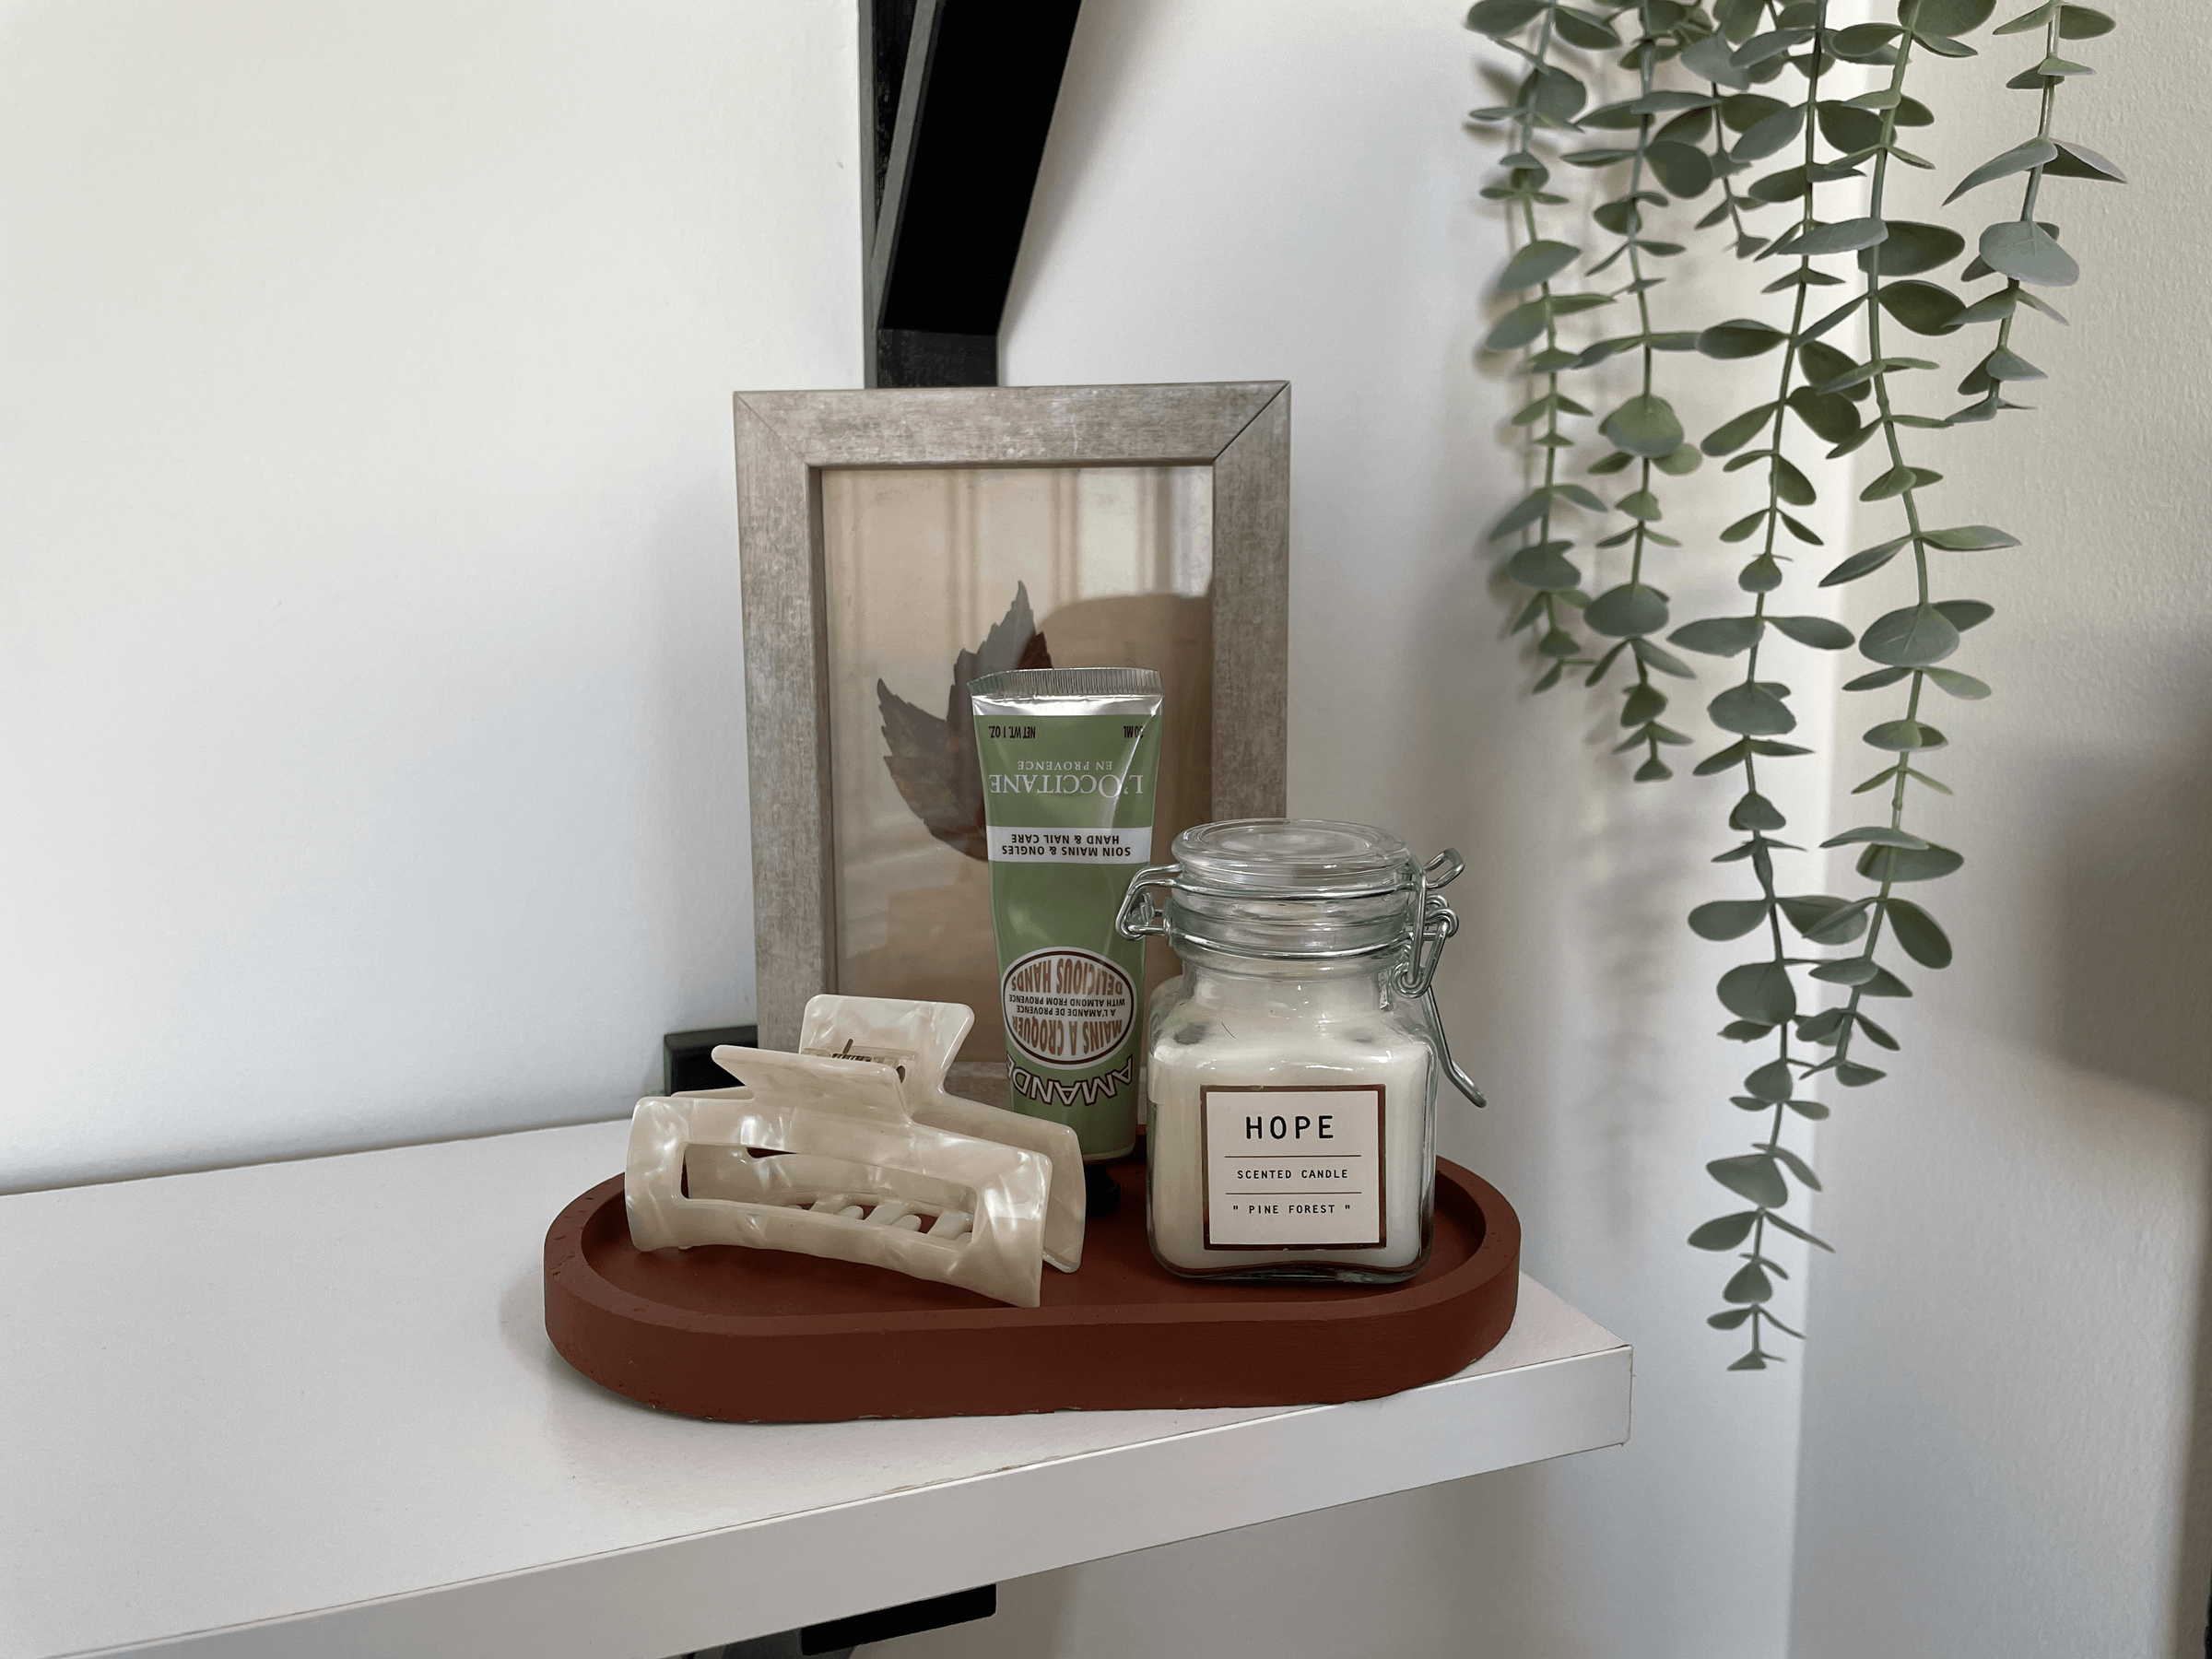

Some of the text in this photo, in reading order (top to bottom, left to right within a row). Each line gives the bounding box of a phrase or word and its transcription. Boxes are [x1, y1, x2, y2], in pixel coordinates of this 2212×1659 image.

[1008, 726, 1022, 738] WT.
[1023, 726, 1036, 738] NET
[1018, 761, 1112, 771] EN PROVENCE
[989, 774, 1144, 798] L'OCCITANE
[1011, 834, 1119, 844] HAND & NAIL CARE
[1002, 845, 1131, 856] SOIN MAINS & ONGLES
[1011, 959, 1123, 995] DELICIOUS HANDS
[1008, 994, 1125, 1006] WITH ALMOND FROM PROVENCE
[1017, 1005, 1116, 1018] A L'AMANDE DE PROVENCE
[1012, 1015, 1123, 1056] MAINS A CROQUER
[1245, 1115, 1335, 1139] HOPE
[1237, 1169, 1348, 1179] SCENTED CANDLE
[1249, 1205, 1279, 1214] PINE
[1288, 1205, 1335, 1214] FOREST
